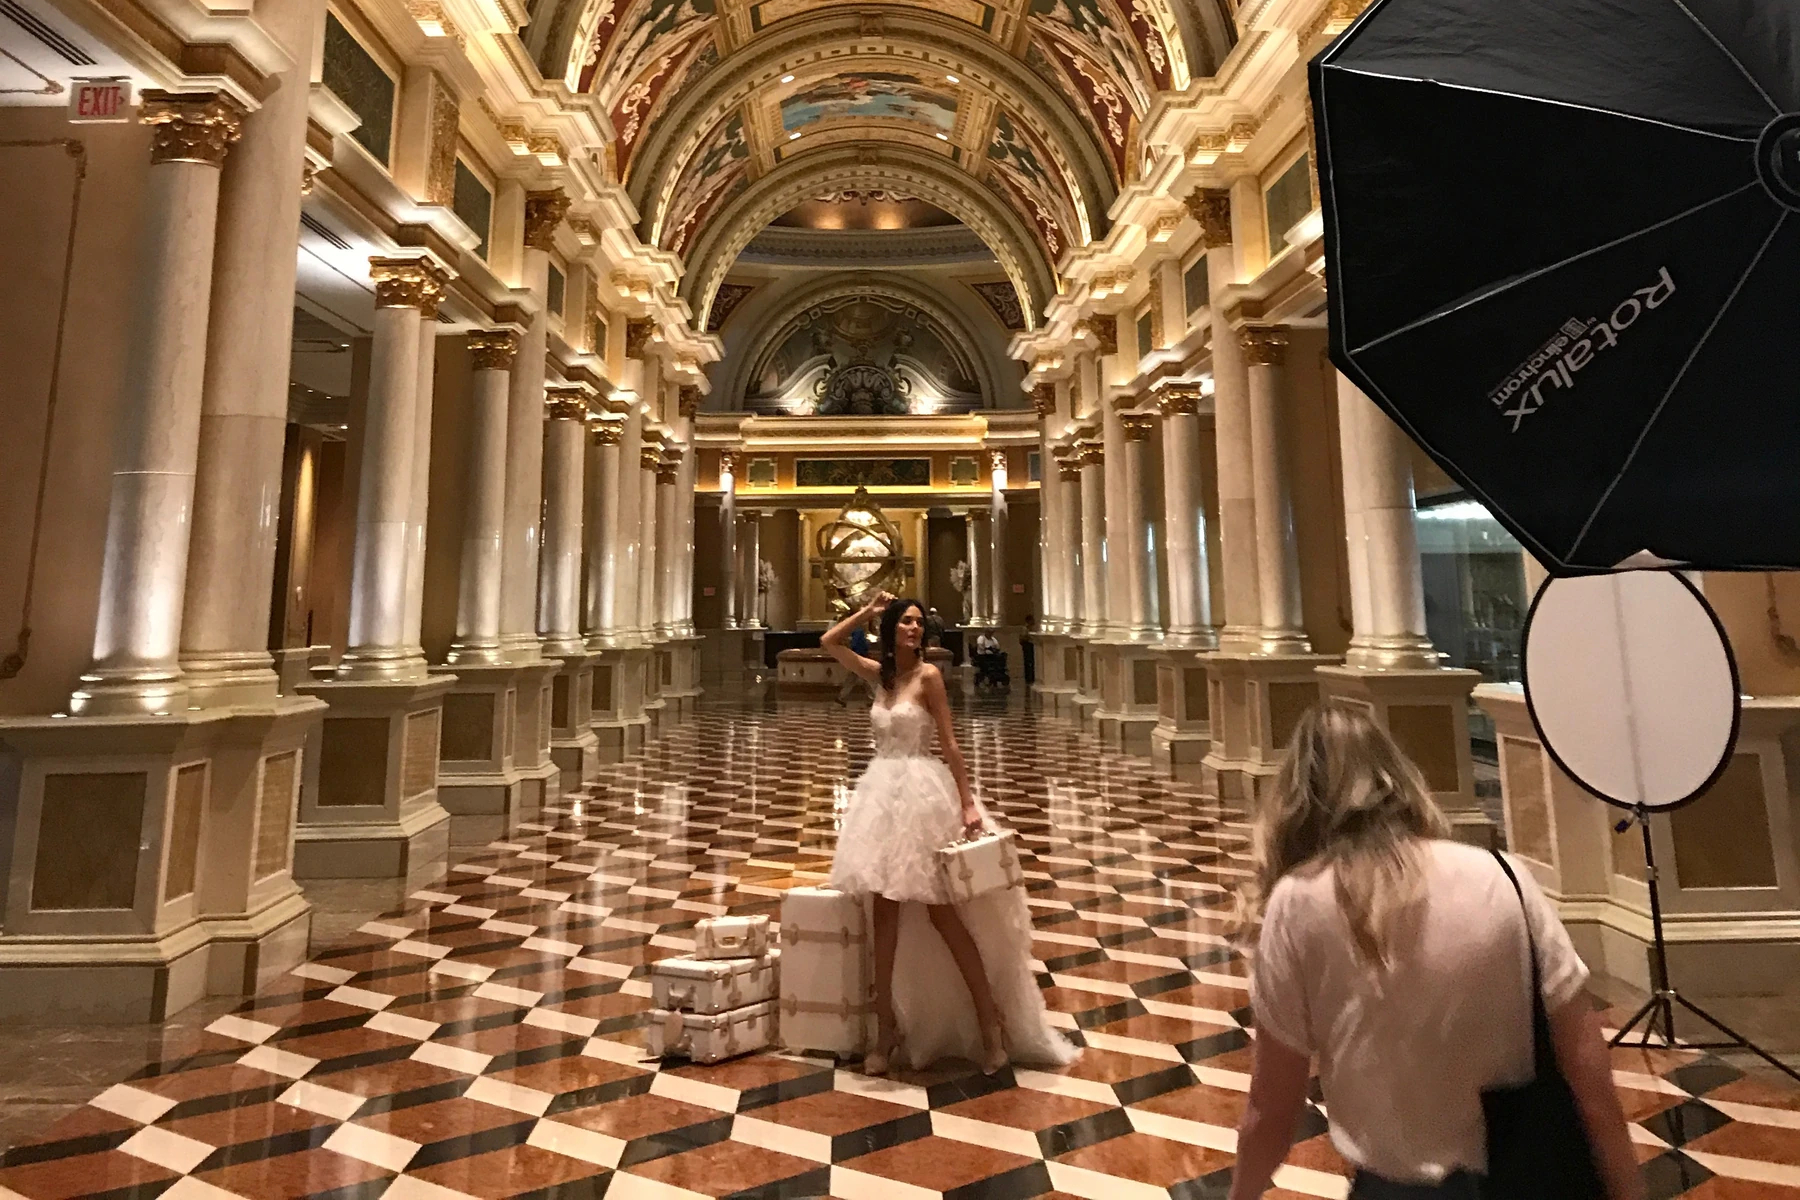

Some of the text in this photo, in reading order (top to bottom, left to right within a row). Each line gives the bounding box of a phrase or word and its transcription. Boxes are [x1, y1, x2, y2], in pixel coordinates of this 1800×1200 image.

[78, 86, 121, 116] EXIT
[1491, 336, 1569, 406] elinchrom
[1503, 266, 1676, 433] Rotalux
